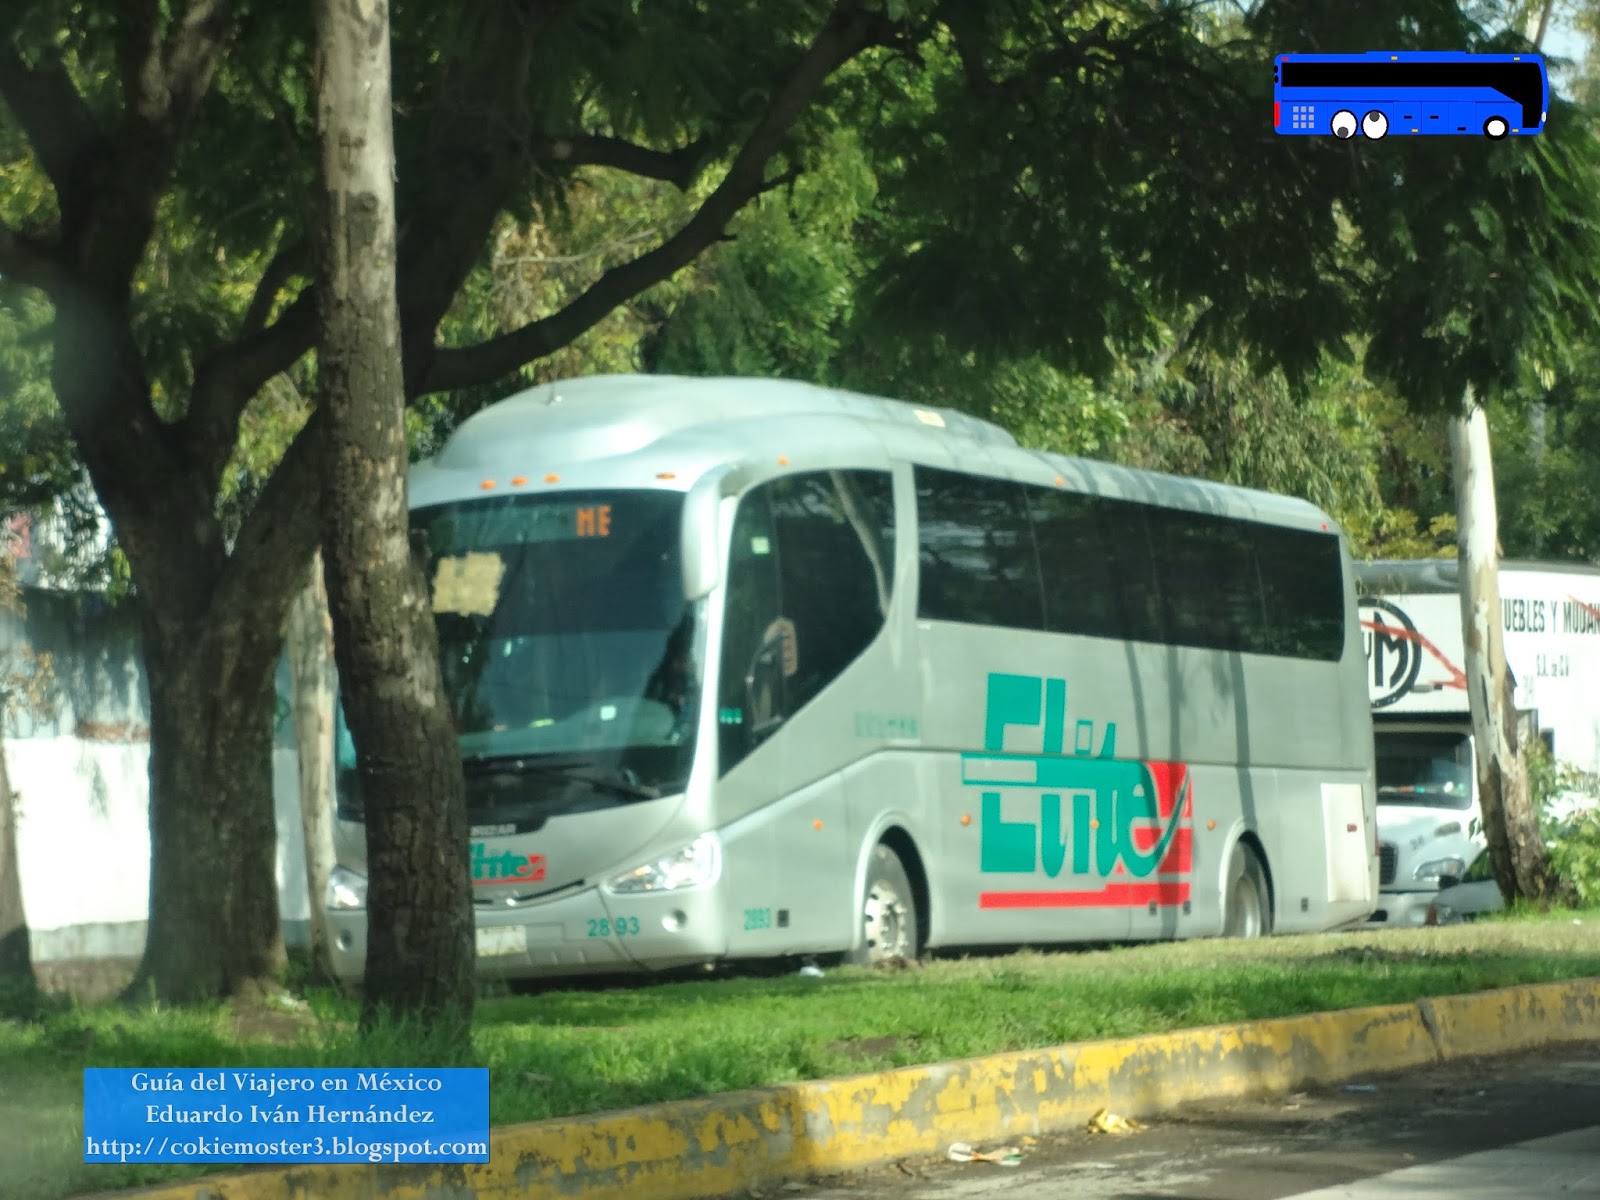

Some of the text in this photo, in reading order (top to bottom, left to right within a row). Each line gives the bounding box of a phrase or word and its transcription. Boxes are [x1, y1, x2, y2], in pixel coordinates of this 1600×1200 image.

[1500, 598, 1545, 633] UEBLES
[1550, 600, 1558, 634] Y
[959, 673, 1191, 878] Elite
[470, 843, 541, 879] lite
[587, 916, 640, 937] 2893
